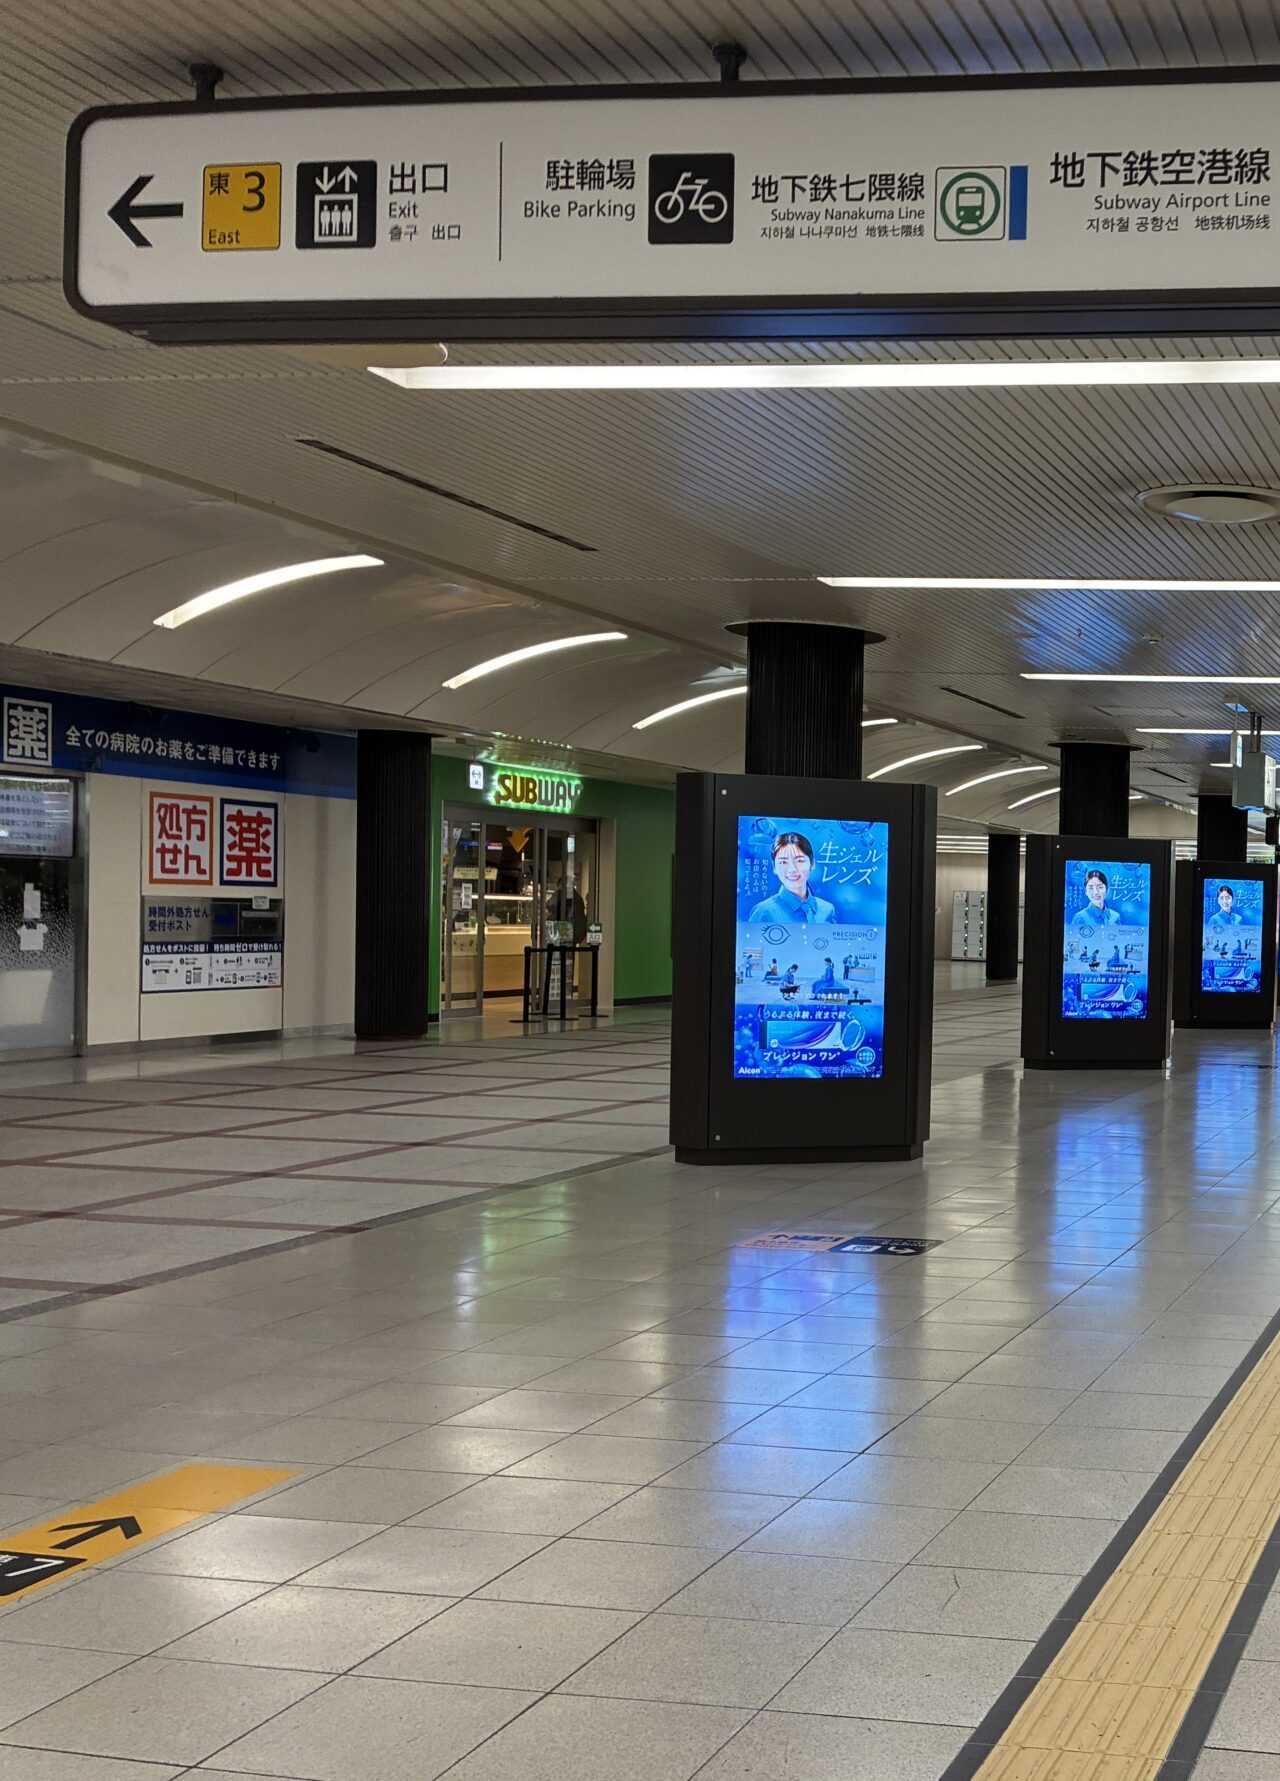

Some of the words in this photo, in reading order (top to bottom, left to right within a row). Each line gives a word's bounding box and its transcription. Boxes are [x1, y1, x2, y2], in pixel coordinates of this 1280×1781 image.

[545, 158, 636, 192] 駐輪場
[1049, 148, 1270, 188] 地下鉄空港線
[388, 162, 449, 195] 出口
[751, 172, 925, 203] 地下鉄七隈線
[208, 172, 230, 195] 東
[242, 171, 267, 213] 3
[1094, 192, 1161, 213] Subway
[1166, 191, 1228, 213] Airport
[1234, 191, 1270, 208] Line
[389, 200, 419, 219] Exit
[523, 201, 562, 218] Bike
[566, 200, 636, 221] Parking
[771, 207, 821, 224] Subway
[824, 207, 894, 221] Nanakuma
[898, 207, 925, 221] Line
[389, 223, 418, 243] 출구
[430, 223, 461, 242] 出口
[760, 223, 795, 240] 지하철
[800, 223, 858, 240] 나나쿠마선
[865, 223, 925, 239] 地铁七隈线
[1086, 216, 1129, 233] 지하철
[1135, 214, 1179, 233] 공항선
[1195, 214, 1270, 232] 地铁机场线
[207, 228, 241, 246] East
[9, 705, 48, 760] 薬
[66, 725, 280, 771] 全ての病院のお薬をご準備できます
[495, 774, 583, 809] SUBWAY
[156, 803, 208, 841] 処方
[226, 809, 272, 877] 薬
[156, 843, 207, 875] せん
[817, 841, 883, 866] 生ジェル
[821, 867, 877, 886] レンズ
[1110, 875, 1147, 890] 生ジェル
[1112, 890, 1145, 902] レンズ
[148, 920, 192, 932] 受付ポスト
[739, 1066, 760, 1074] Alcon
